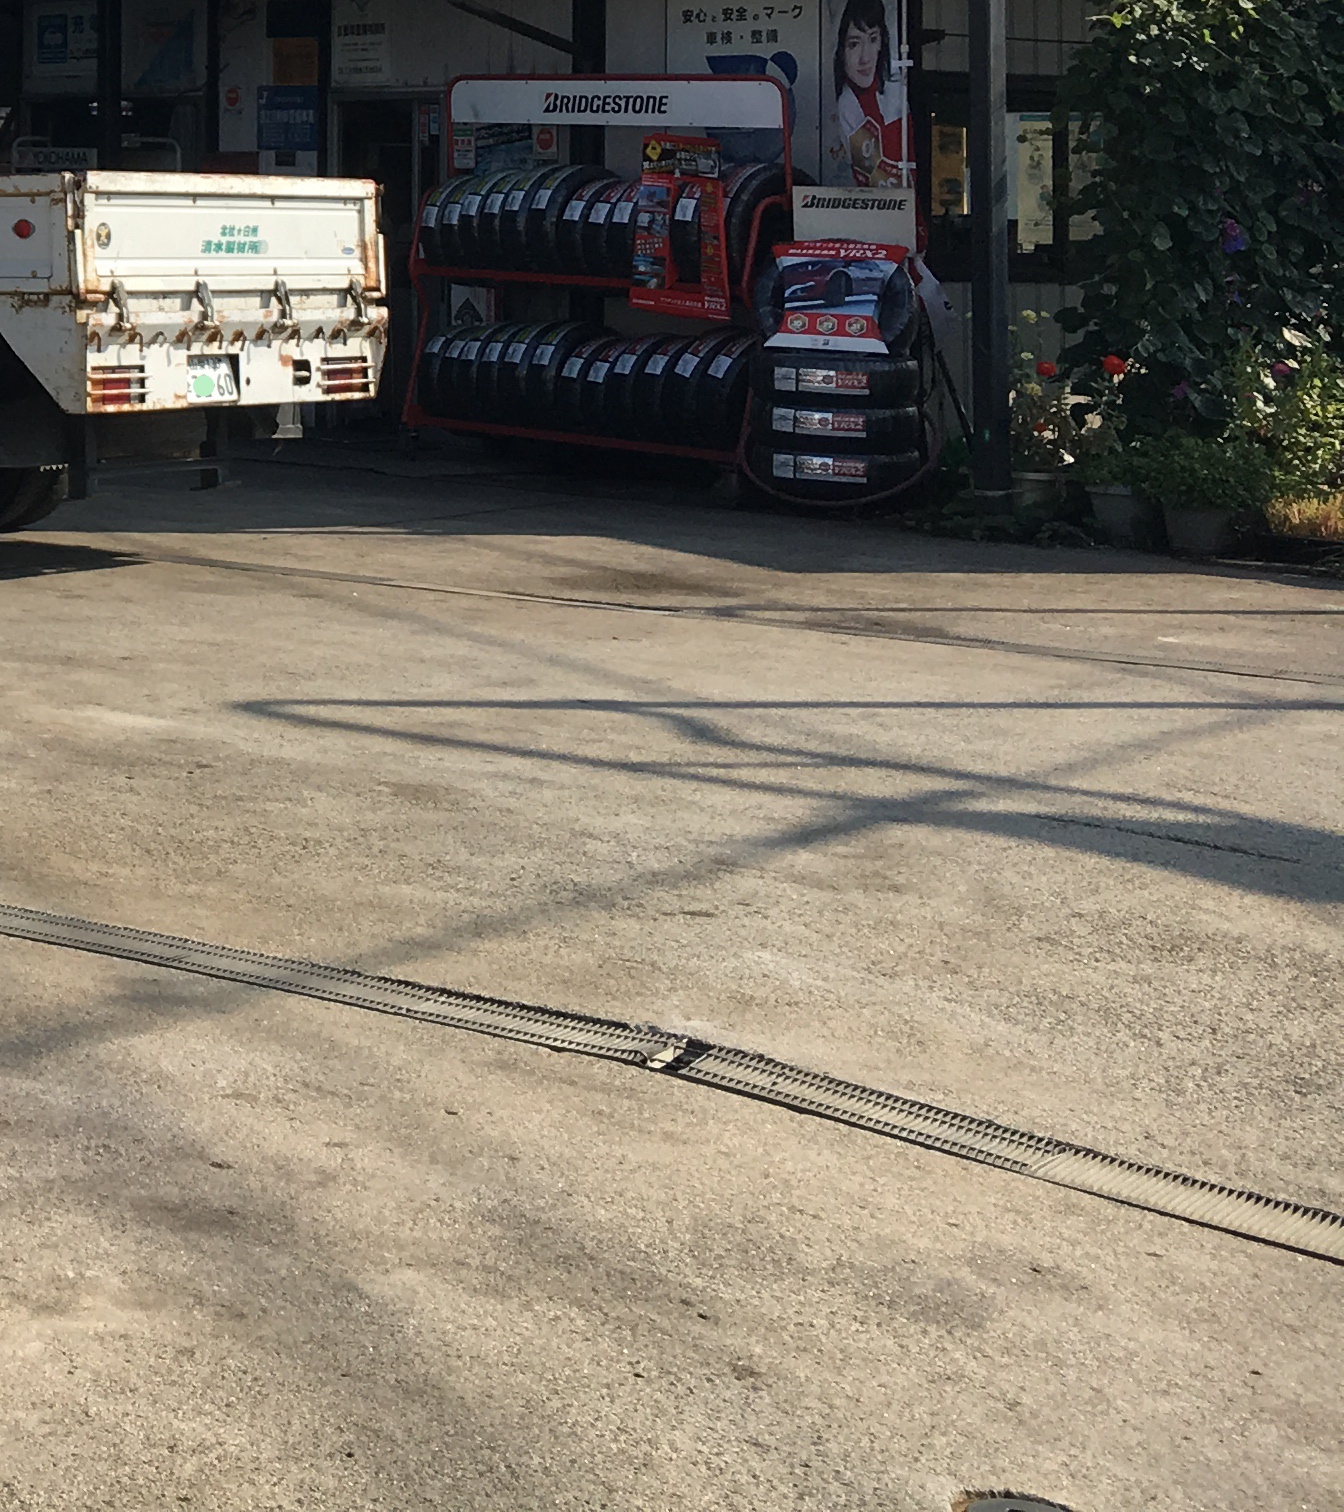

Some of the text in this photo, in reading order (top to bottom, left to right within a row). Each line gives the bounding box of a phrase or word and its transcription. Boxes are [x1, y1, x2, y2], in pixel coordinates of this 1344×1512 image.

[542, 92, 669, 114] BRIDGESTONE
[801, 194, 908, 211] BRIDGESTONE
[838, 248, 888, 259] VRX2
